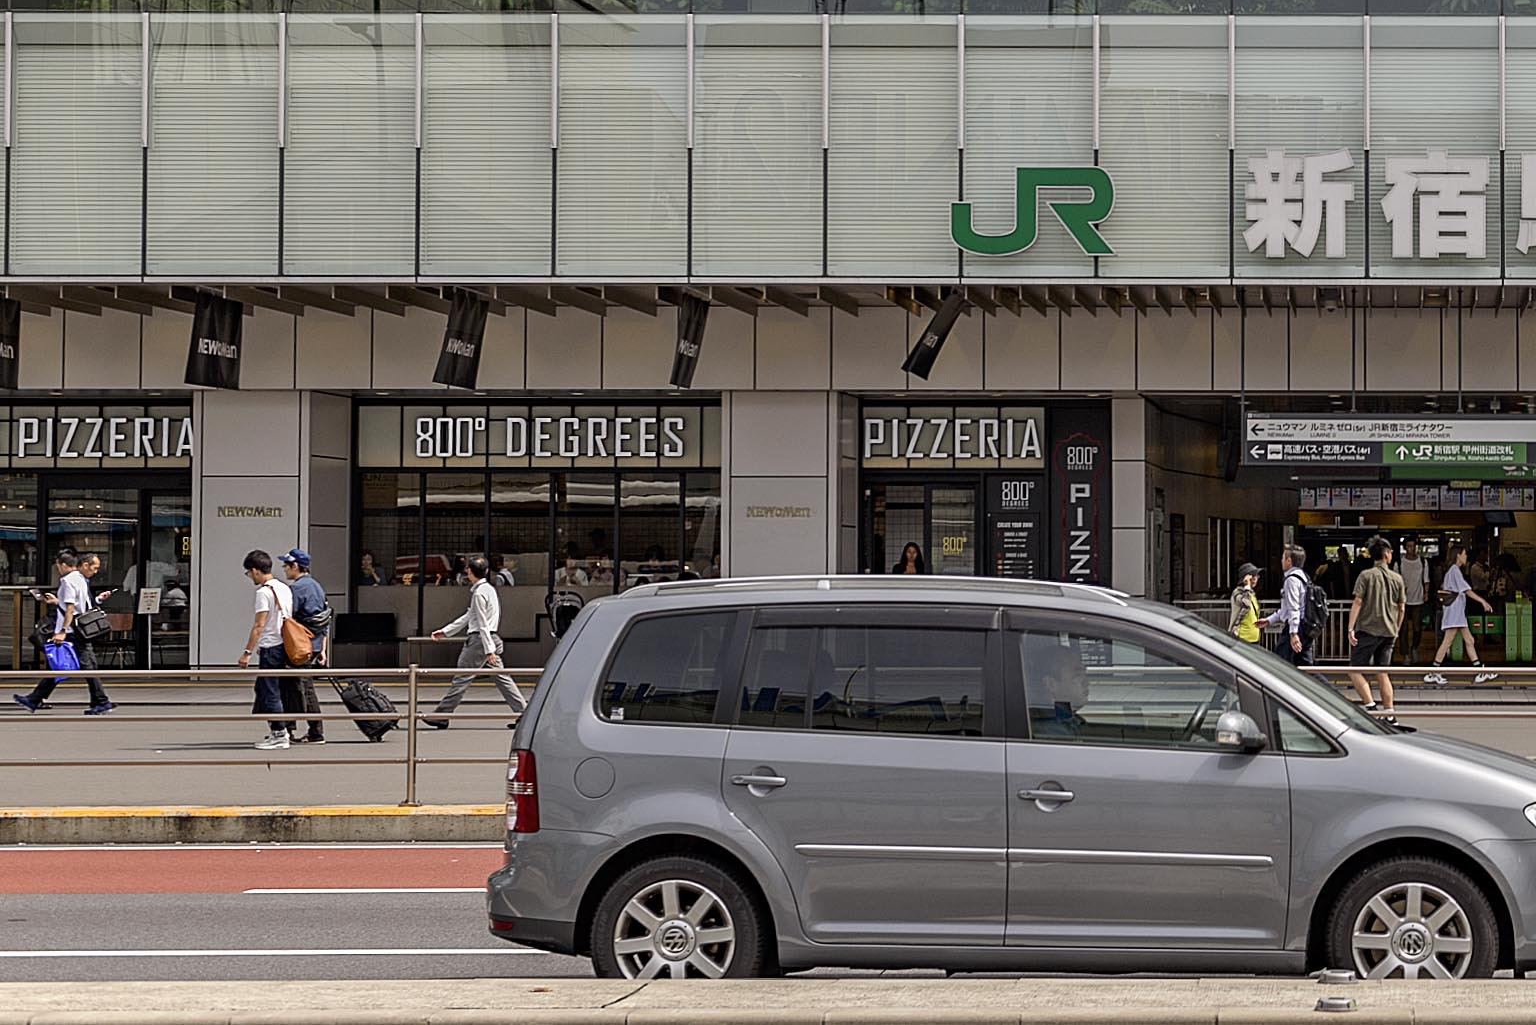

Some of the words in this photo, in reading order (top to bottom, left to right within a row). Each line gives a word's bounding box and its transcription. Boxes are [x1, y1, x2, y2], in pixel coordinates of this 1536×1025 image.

[950, 166, 1117, 256] JR
[17, 417, 194, 458] PIZZERIA
[506, 417, 684, 457] DEGREES
[864, 418, 1042, 459] PIZZERIA
[1412, 445, 1433, 456] JR
[1069, 483, 1091, 581] PIZZ
